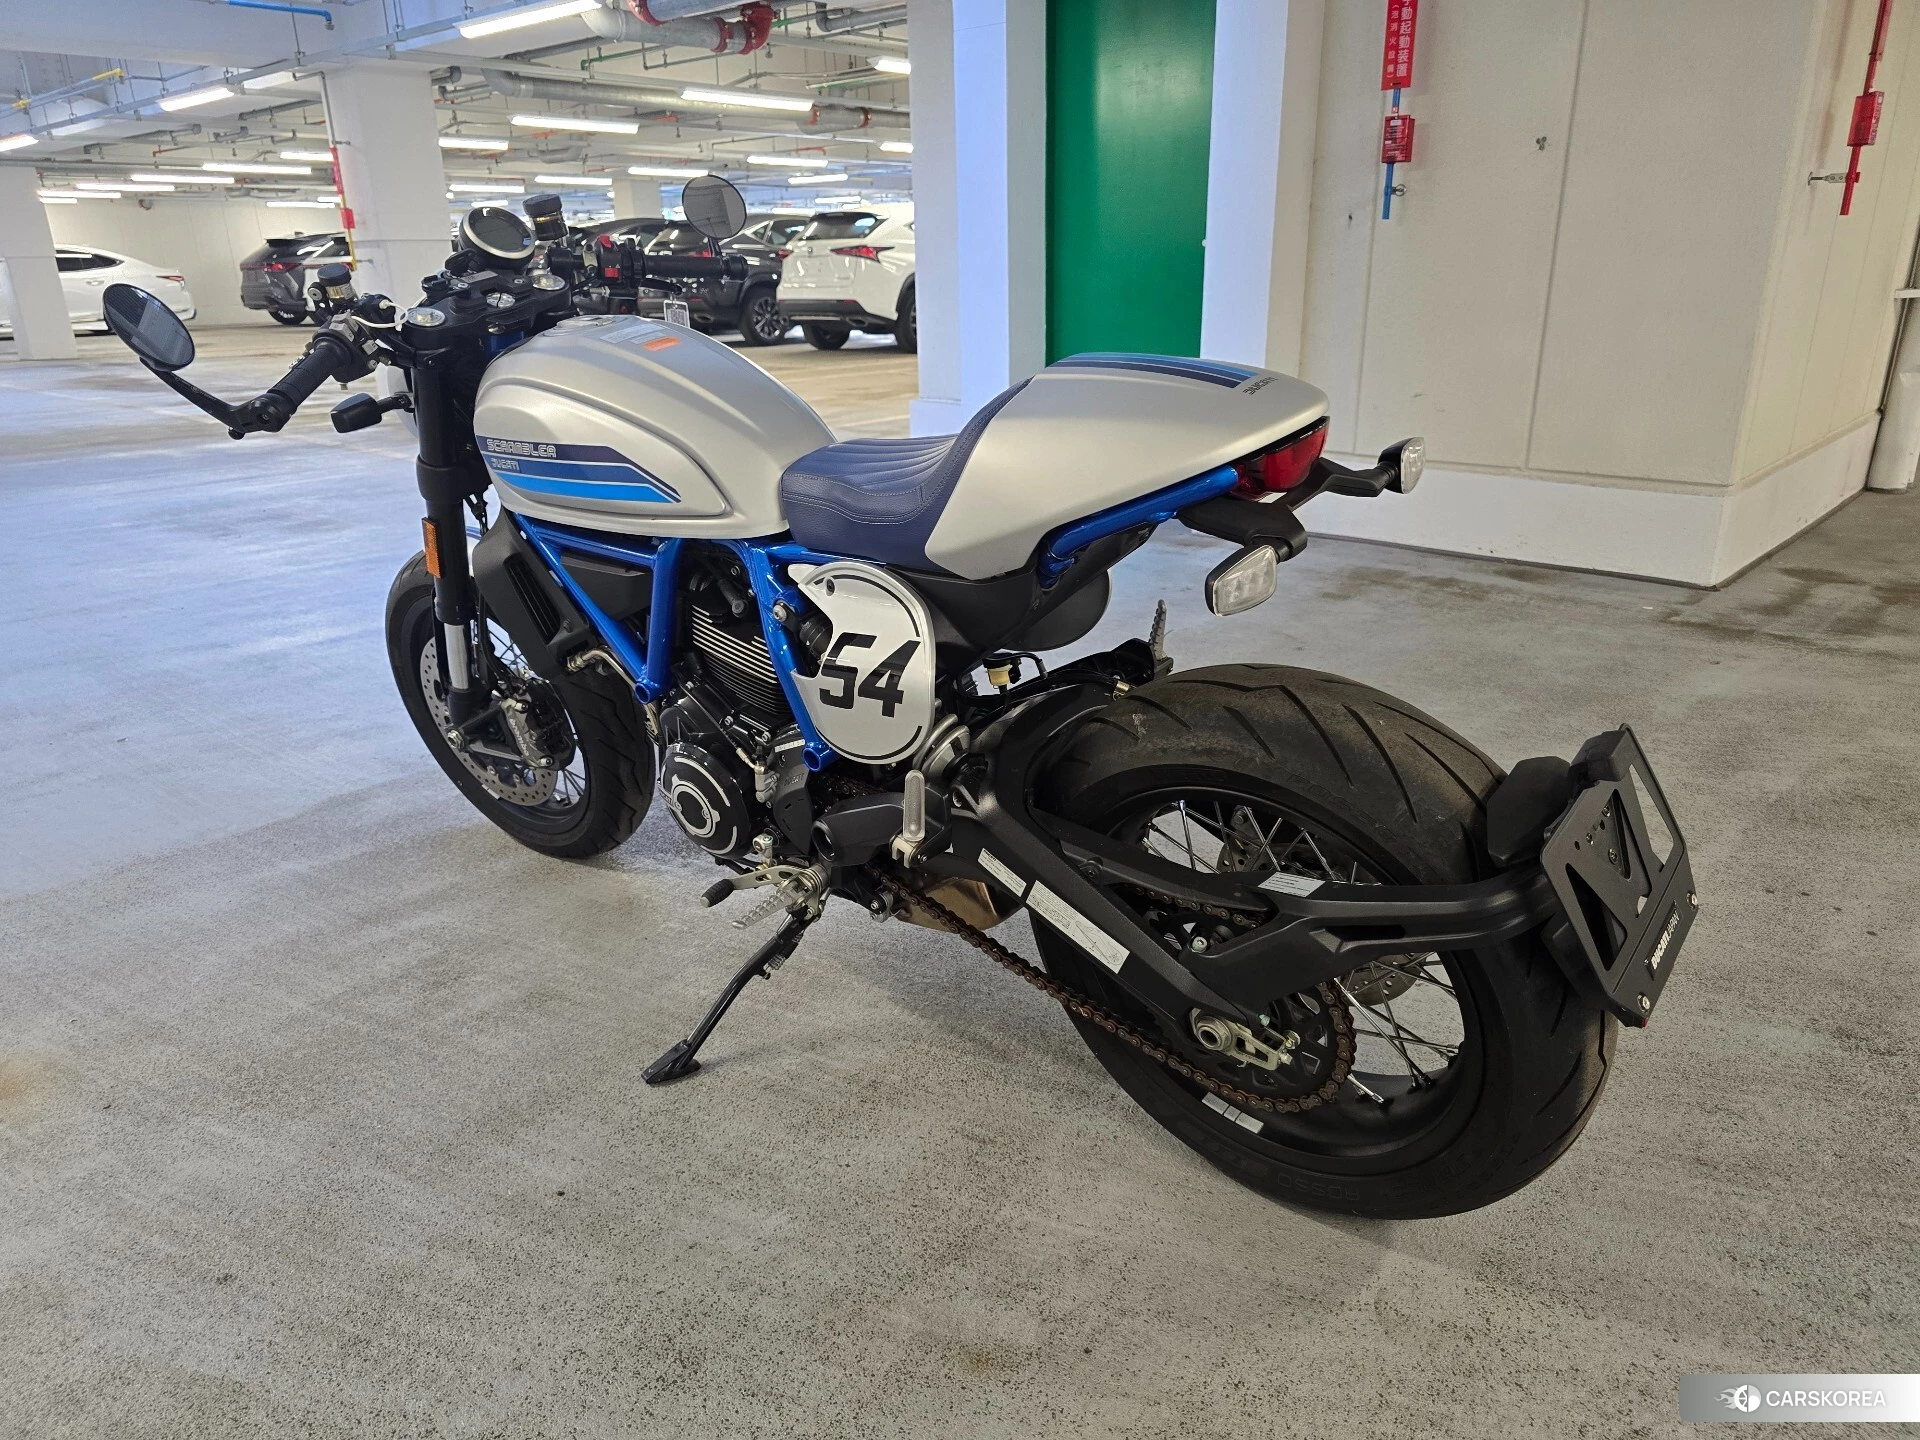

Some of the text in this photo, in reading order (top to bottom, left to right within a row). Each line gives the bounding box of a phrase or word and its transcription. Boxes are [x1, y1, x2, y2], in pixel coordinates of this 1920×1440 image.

[486, 439, 557, 458] SCRAMBLER
[490, 457, 520, 471] DUCATI
[819, 632, 921, 718] 54
[509, 718, 529, 756] brembo
